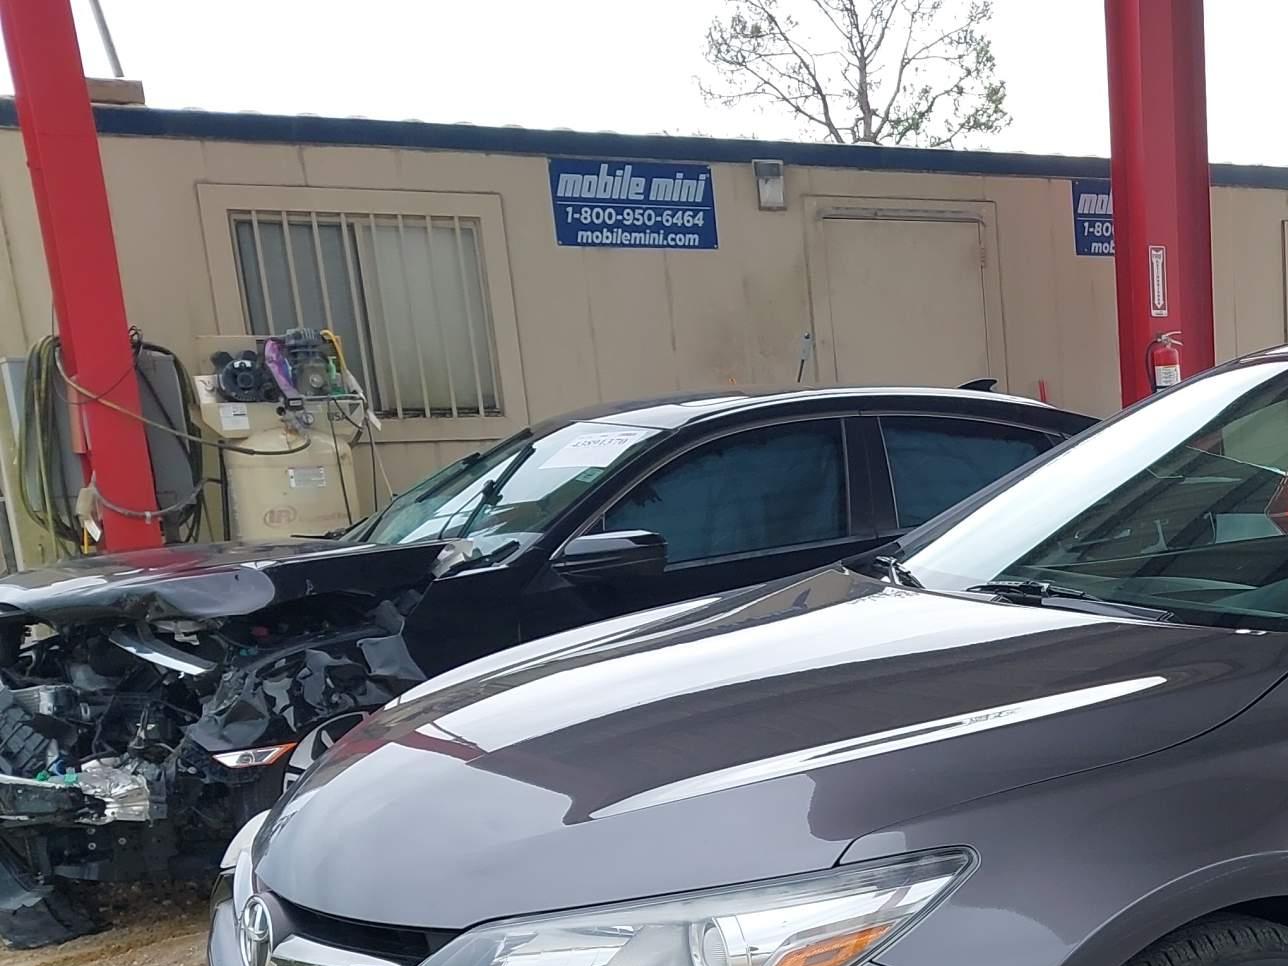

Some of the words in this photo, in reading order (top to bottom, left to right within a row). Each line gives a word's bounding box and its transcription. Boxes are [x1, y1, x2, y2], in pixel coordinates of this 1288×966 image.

[556, 163, 646, 200] mobile
[649, 172, 706, 203] mini
[565, 206, 705, 228] 1-800-950-6464
[577, 228, 700, 246] mobilemini.com
[1083, 221, 1114, 237] 1-80
